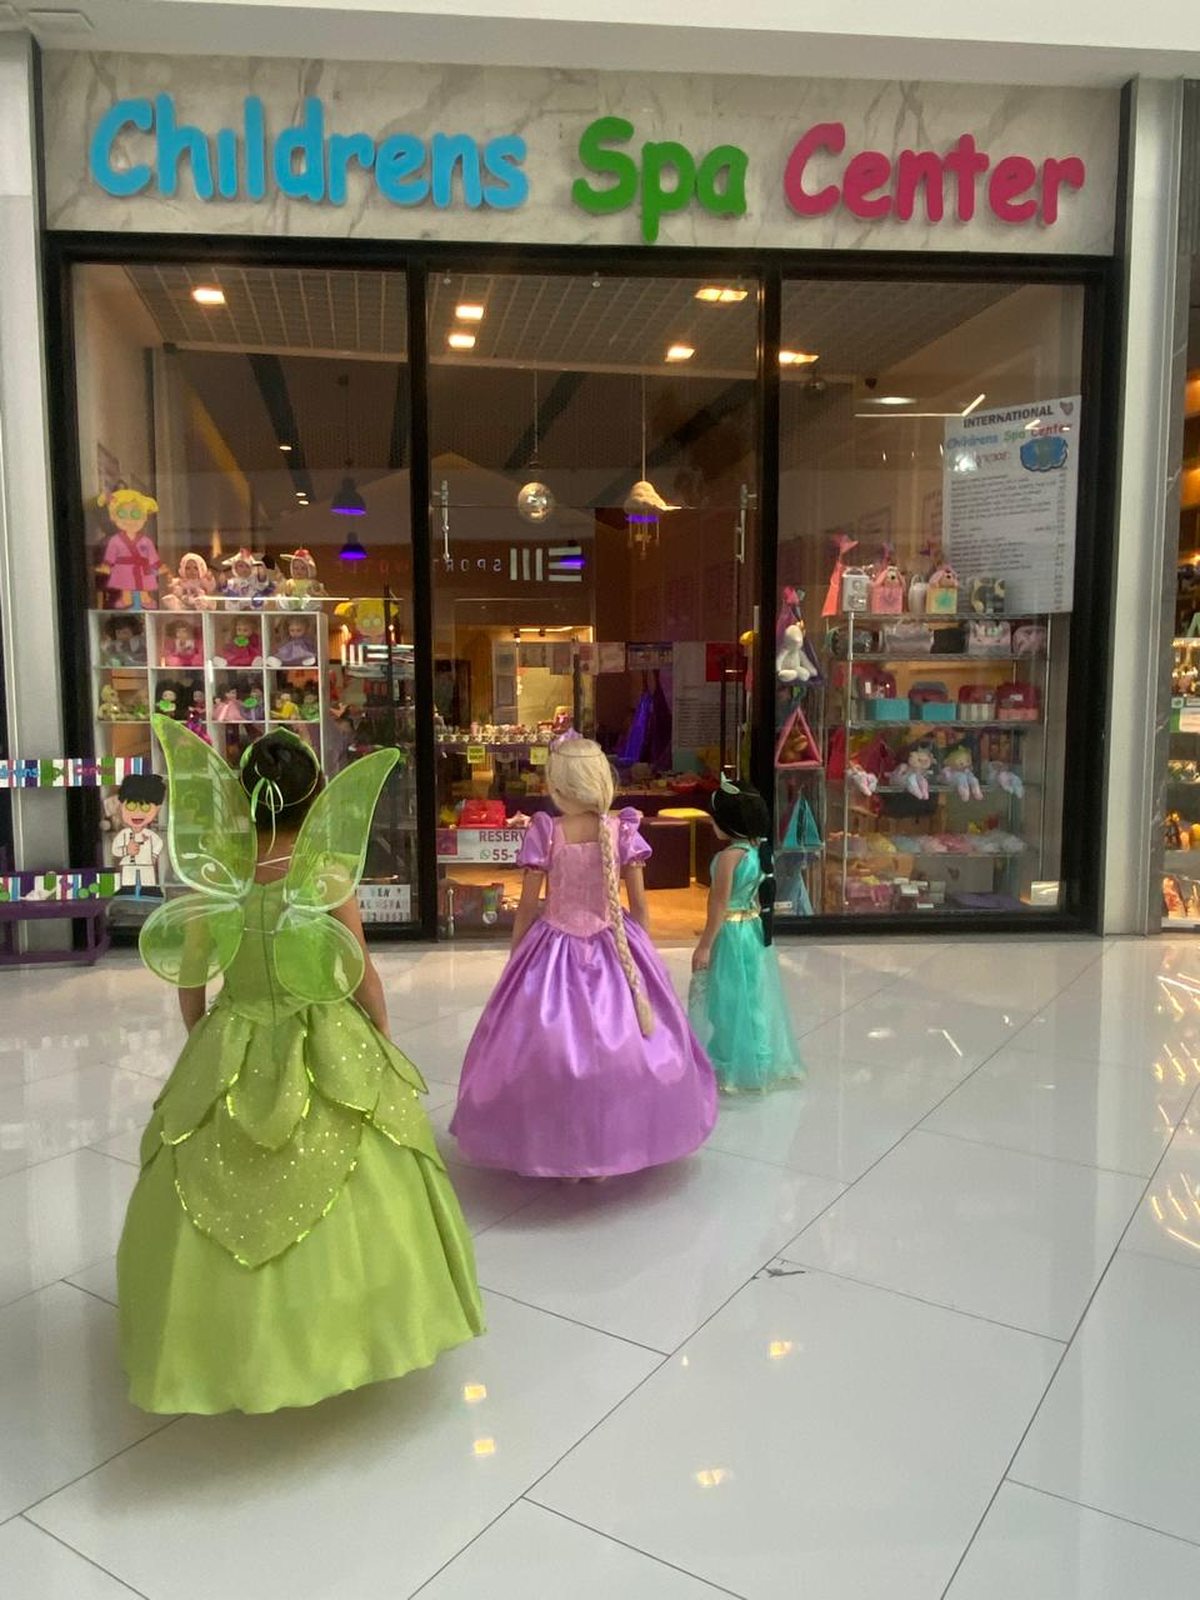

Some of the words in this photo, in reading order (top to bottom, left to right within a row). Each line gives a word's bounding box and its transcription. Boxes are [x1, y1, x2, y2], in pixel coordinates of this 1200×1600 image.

[90, 93, 529, 210] Childrens
[572, 116, 748, 243] Spa
[784, 122, 1085, 225] Center
[963, 404, 1054, 428] INTERNATIONAL
[1004, 429, 1026, 443] Spa
